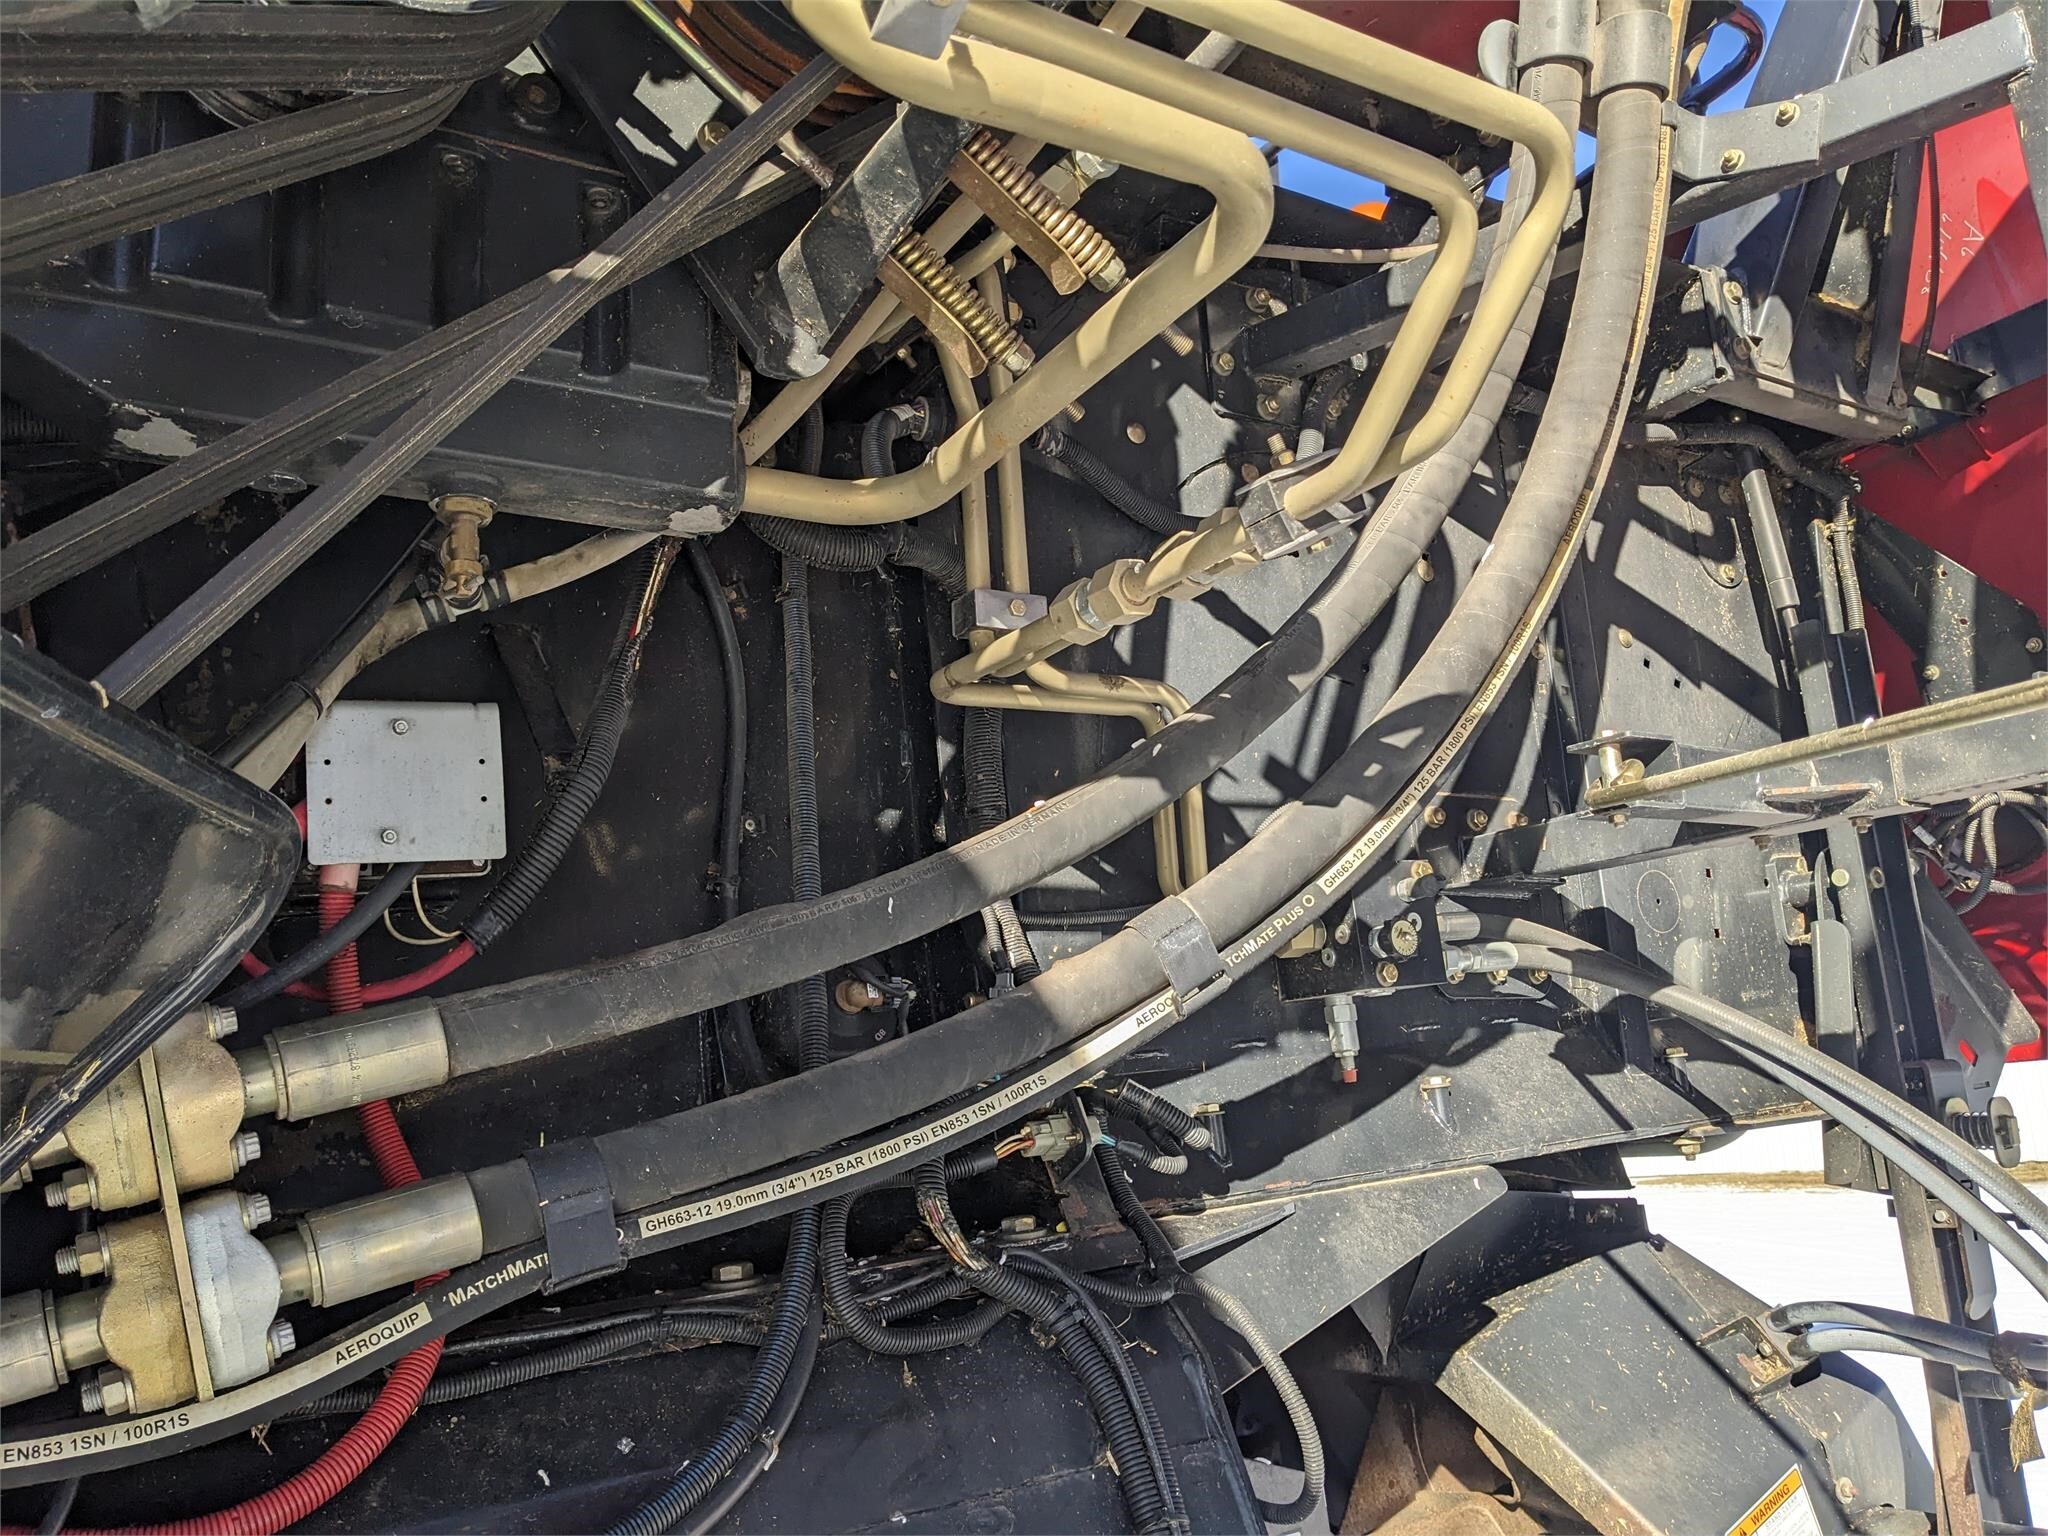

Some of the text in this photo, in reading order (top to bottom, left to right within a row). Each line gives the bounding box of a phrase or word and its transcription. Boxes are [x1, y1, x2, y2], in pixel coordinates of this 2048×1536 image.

[1323, 848, 1366, 889] GH663-12
[1364, 817, 1396, 849] 19.0mm
[1395, 793, 1417, 819] (3/4")
[1413, 777, 1430, 794] 125
[1427, 755, 1447, 778] BAR
[1443, 731, 1464, 757] (1800
[1475, 683, 1498, 713] EN853
[1135, 994, 1175, 1028] AEROQ
[1225, 926, 1277, 968] TCHMATE
[645, 1204, 713, 1233] GH663-12
[716, 1189, 769, 1213] 19.0mm
[772, 1175, 807, 1198] (3/4")
[809, 1167, 833, 1184] 125
[836, 1155, 866, 1175] BAR
[868, 1141, 901, 1164] (1800
[903, 1130, 930, 1150] PSI)
[931, 1115, 970, 1138] EN853
[971, 1101, 997, 1119] 1SN
[1005, 1074, 1048, 1103] 100R1S
[335, 1311, 420, 1365] AEROQUIP
[3, 1413, 190, 1463] EN853 1SN / 100R1S
[1750, 1483, 1791, 1527] WARNING
